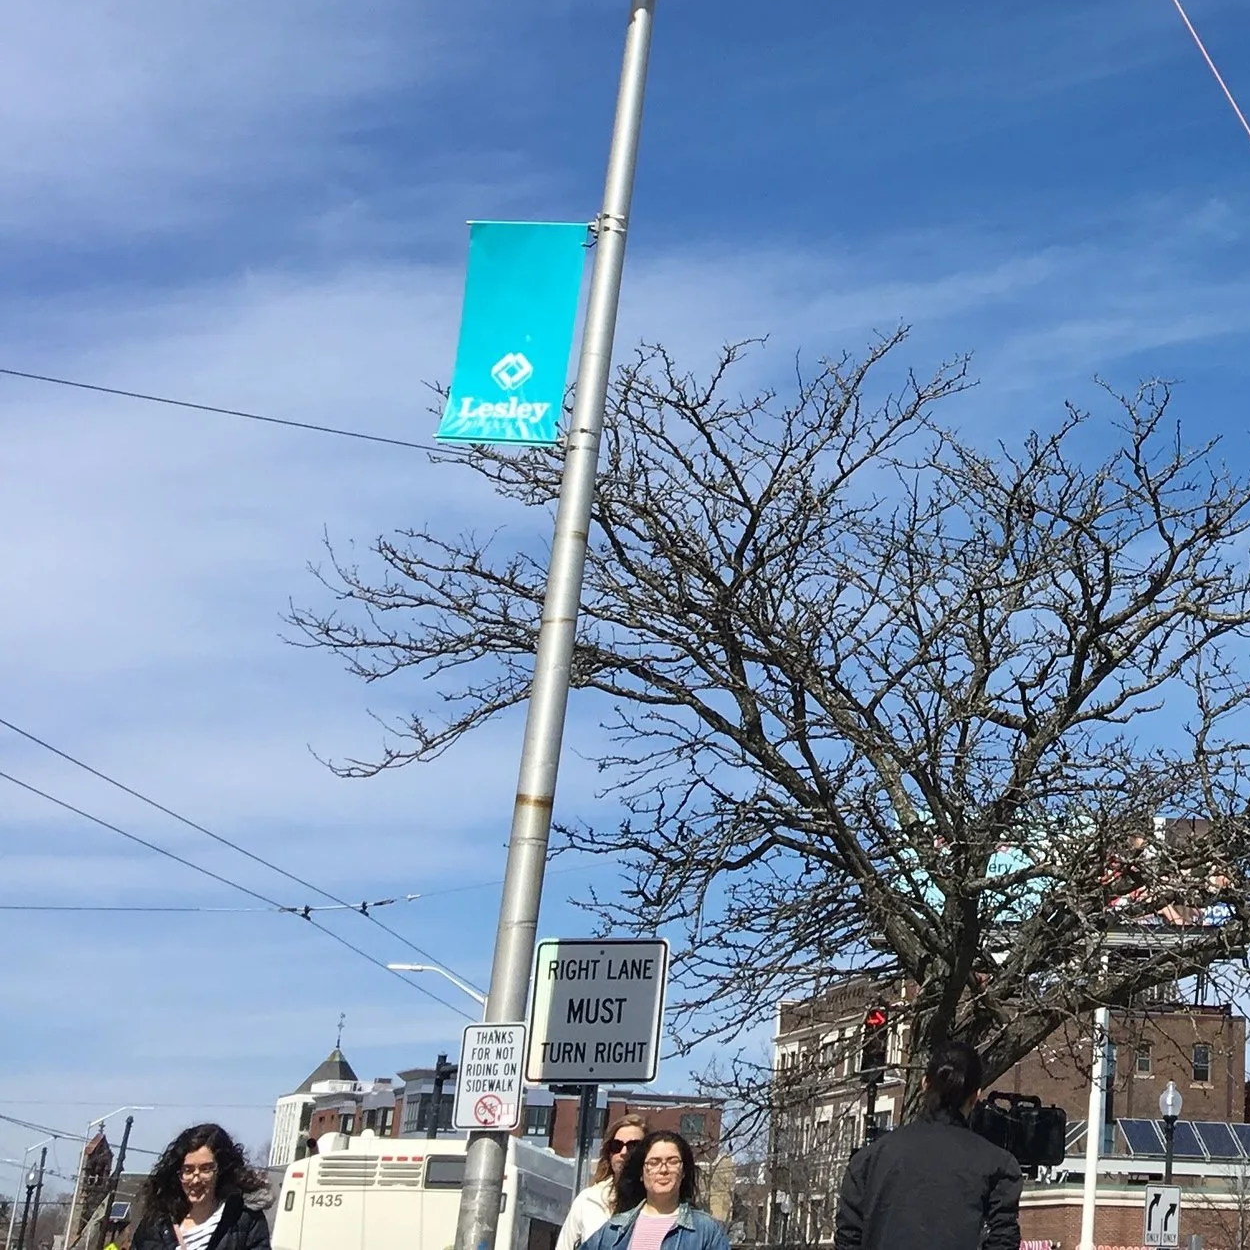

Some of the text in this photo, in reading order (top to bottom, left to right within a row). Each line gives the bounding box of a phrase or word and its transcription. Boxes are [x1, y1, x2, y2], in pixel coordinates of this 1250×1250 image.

[459, 396, 551, 423] Lesley
[548, 959, 654, 980] RIGHT LANE
[566, 998, 627, 1024] MUST
[476, 1031, 514, 1045] THANKS
[471, 1047, 515, 1061] FOR NOT
[541, 1042, 647, 1063] TURN RIGHT
[466, 1063, 517, 1077] RIDING ON
[466, 1079, 513, 1093] SIDEWALK
[310, 1194, 342, 1207] 1435
[1146, 1232, 1177, 1243] ONLY ONLY
